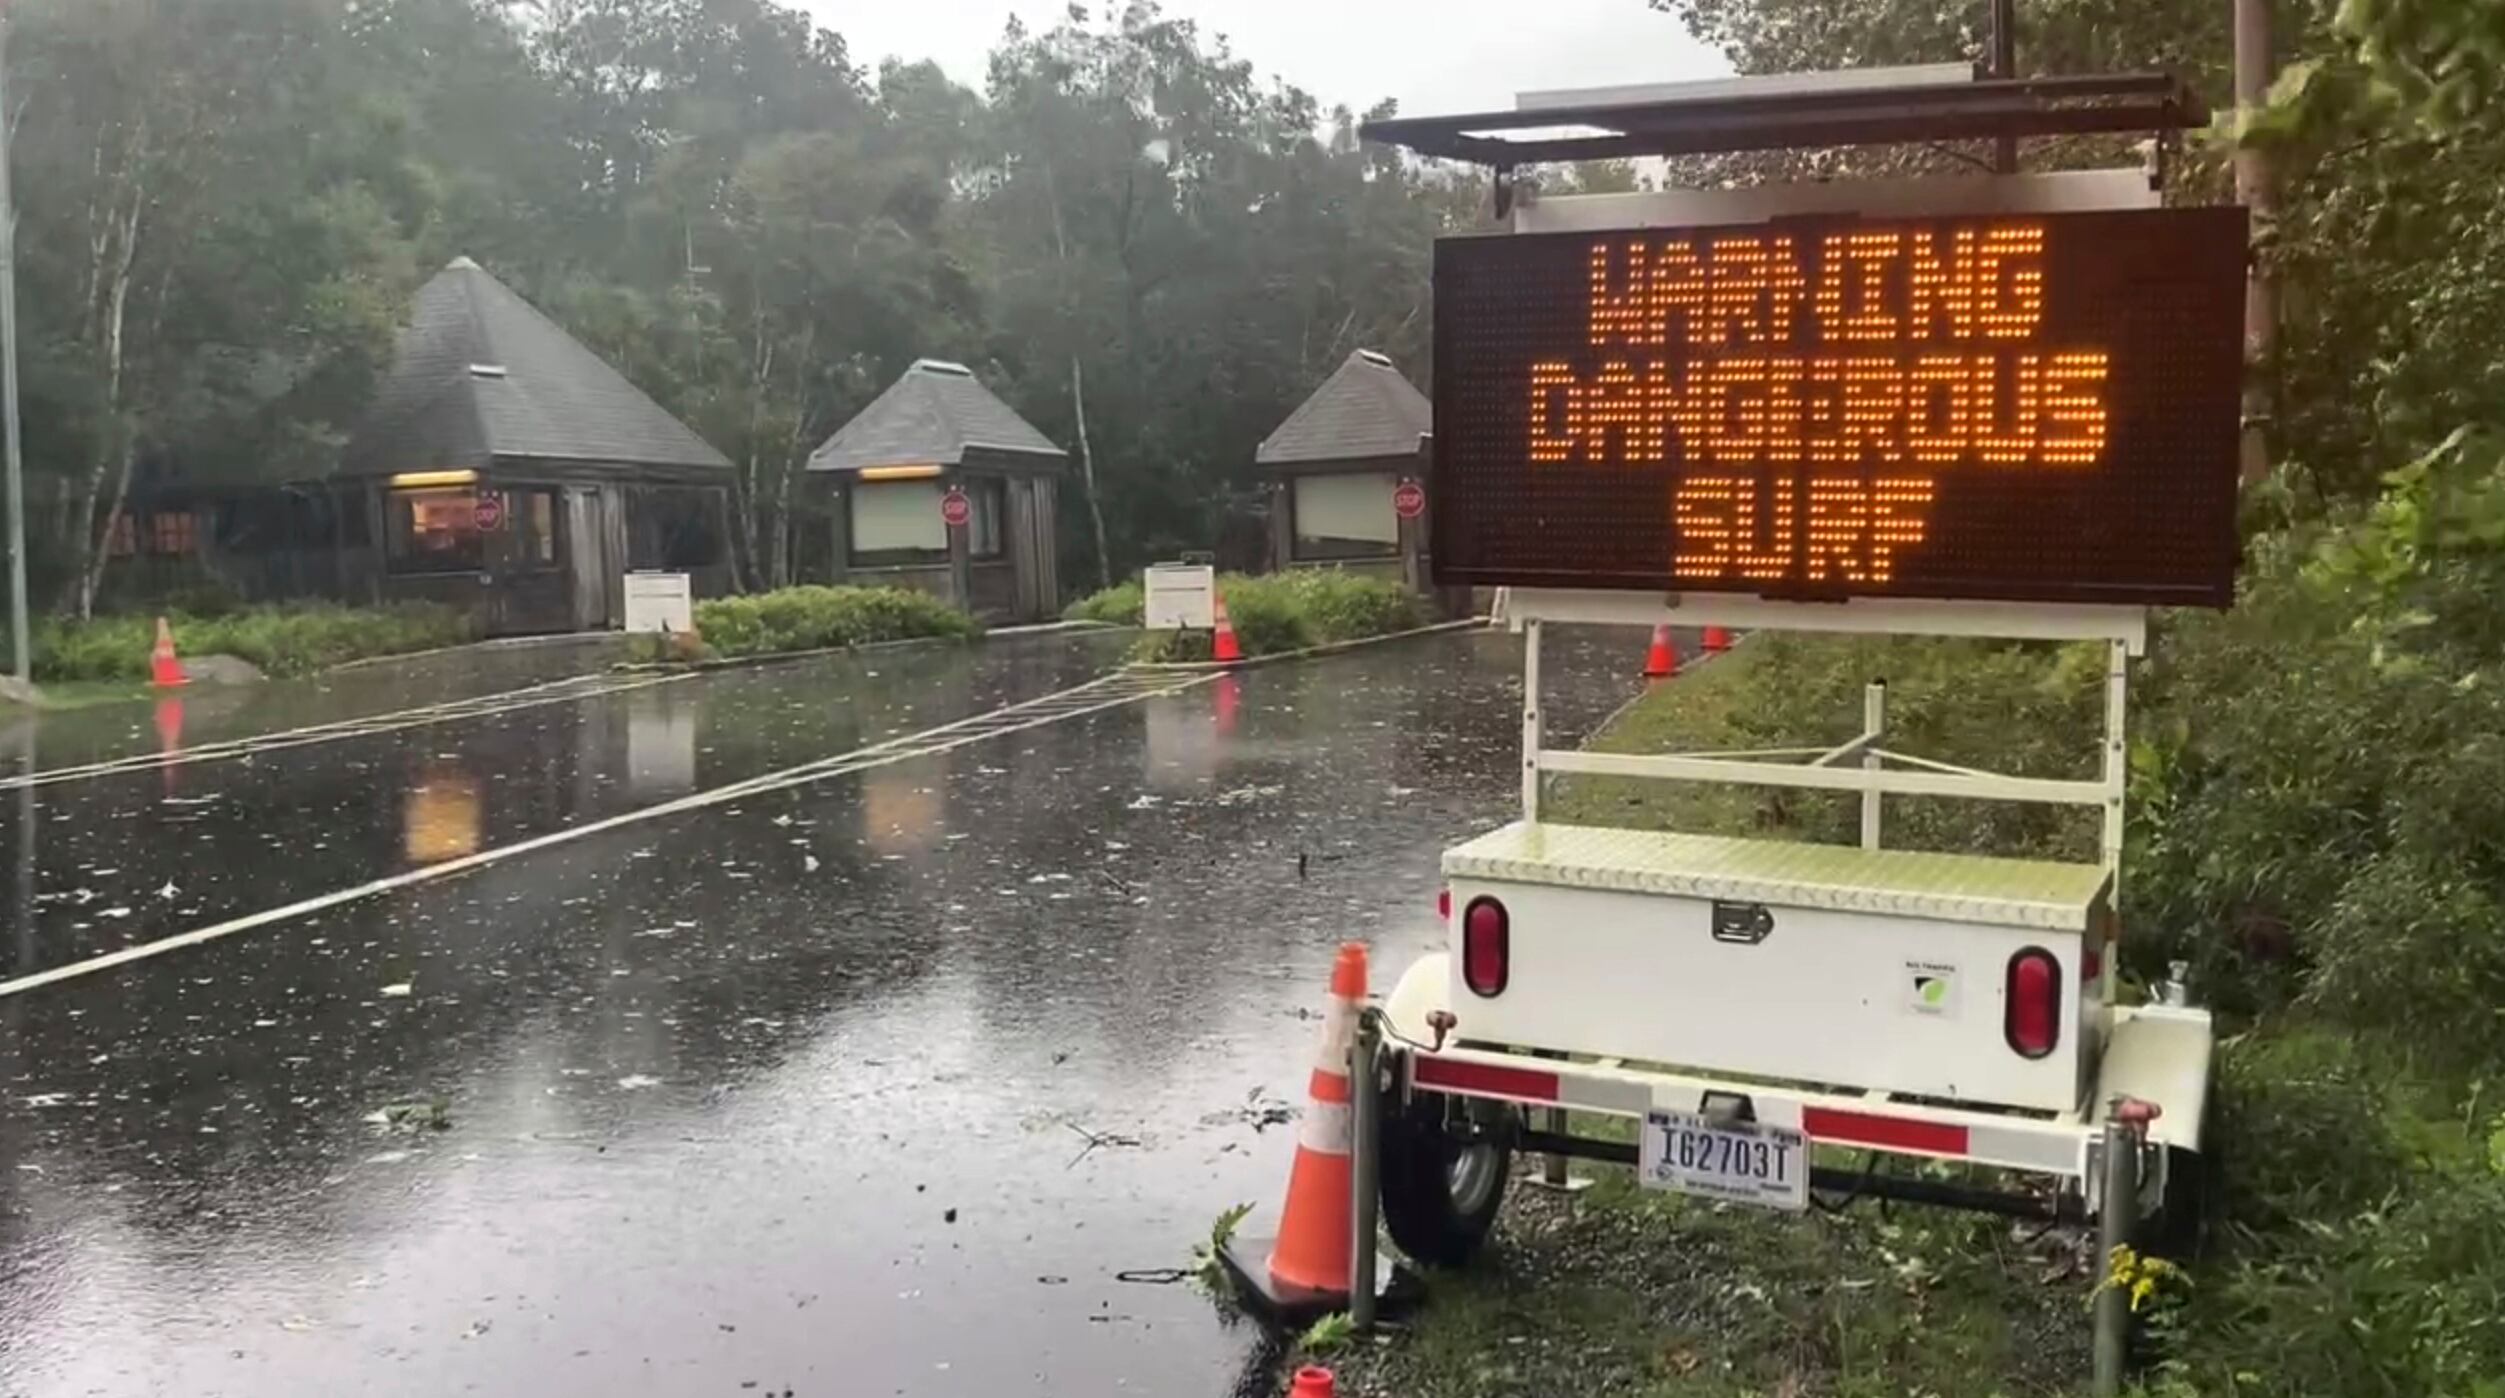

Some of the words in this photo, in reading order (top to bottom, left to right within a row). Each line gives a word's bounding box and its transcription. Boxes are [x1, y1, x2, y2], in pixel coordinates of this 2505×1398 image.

[1590, 228, 2043, 344] WARNING
[1528, 353, 2109, 464] DANGEROUS
[944, 501, 967, 514] STOP
[1397, 493, 1420, 507] STOP
[1674, 477, 1935, 582] SURF
